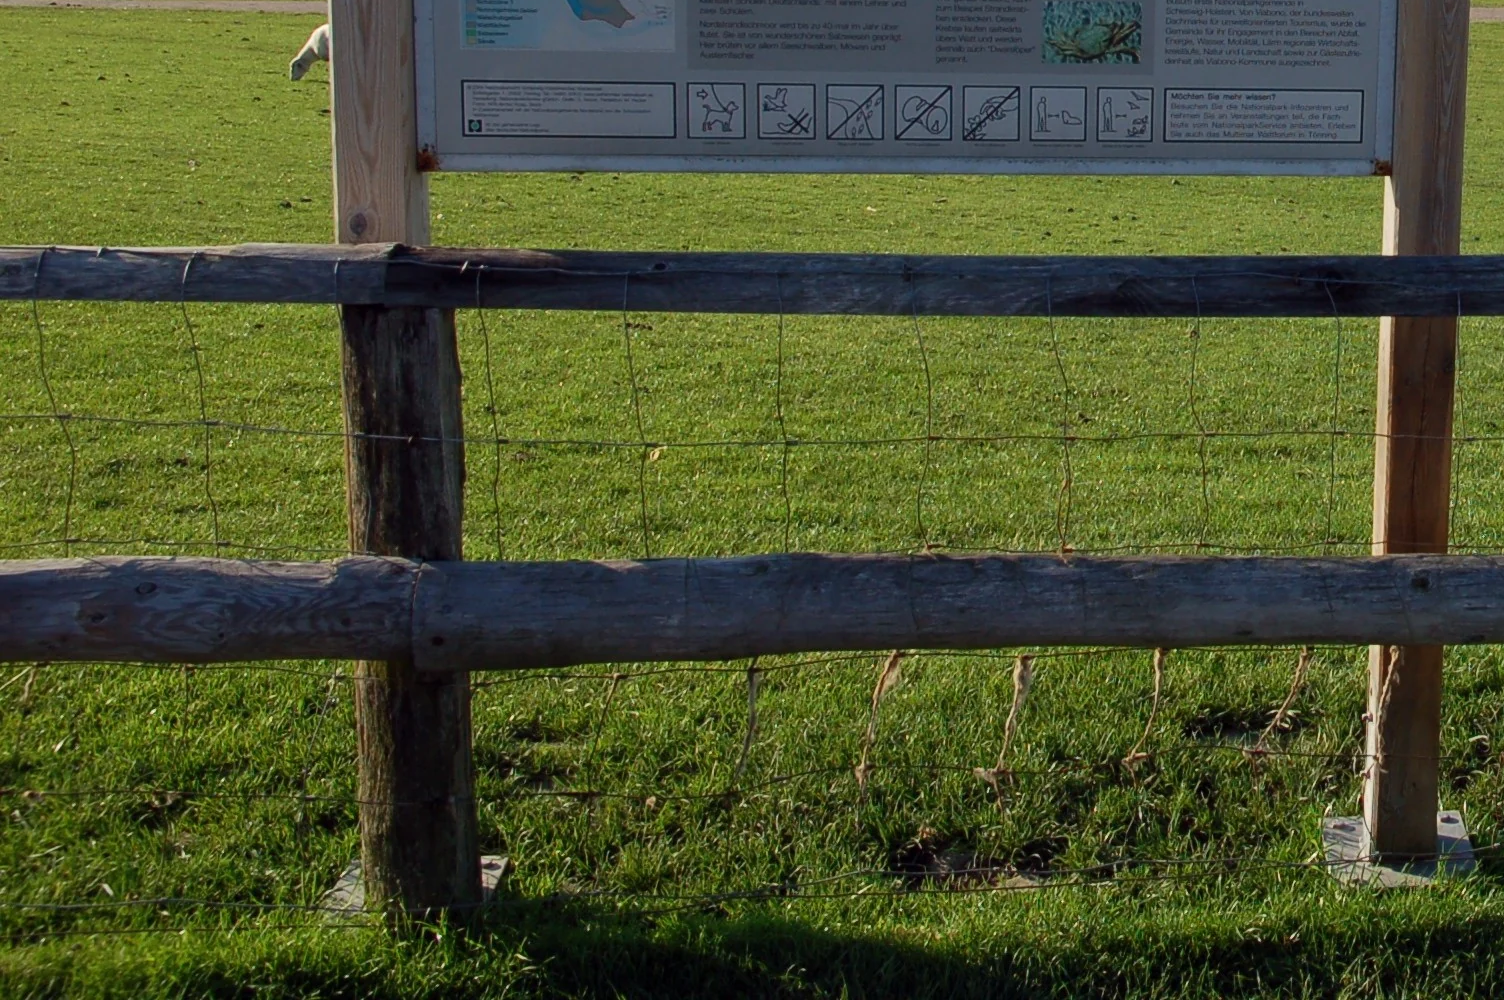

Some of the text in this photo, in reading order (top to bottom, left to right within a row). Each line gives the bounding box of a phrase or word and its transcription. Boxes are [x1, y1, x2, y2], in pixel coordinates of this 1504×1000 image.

[1171, 92, 1276, 101] Möchten Sie mehr wissen?
